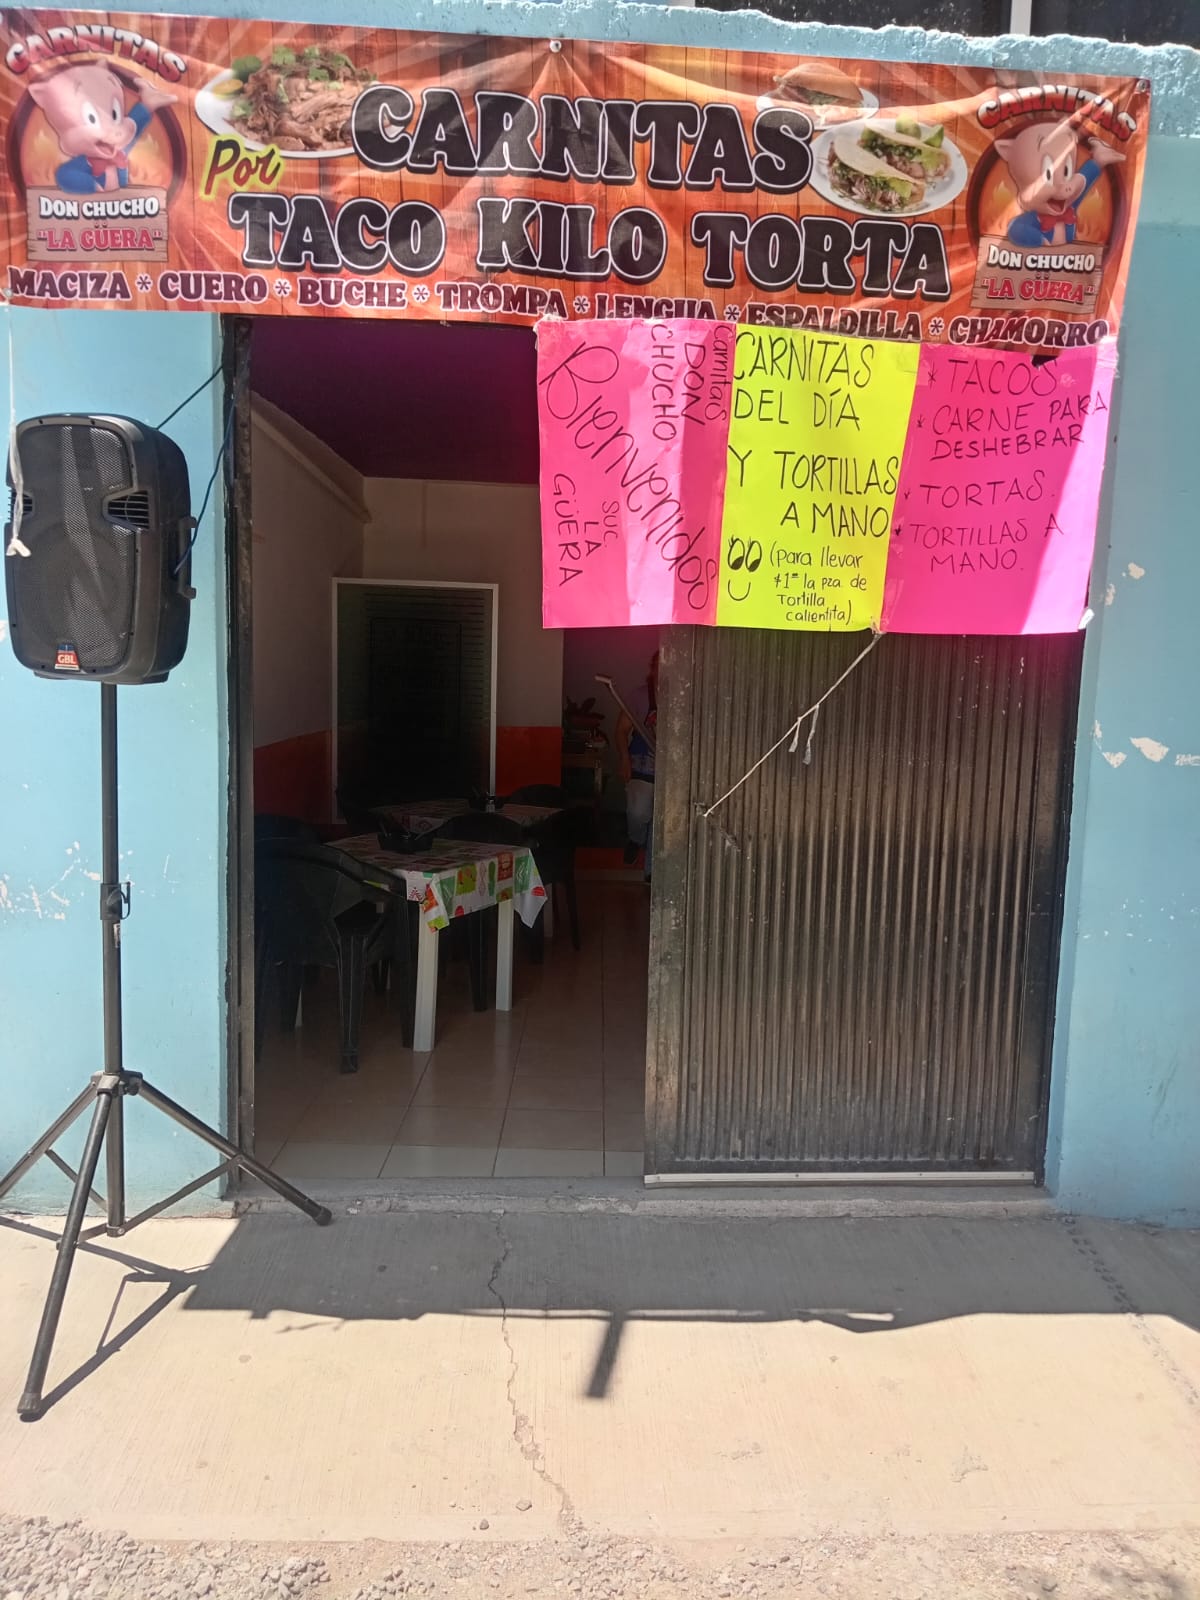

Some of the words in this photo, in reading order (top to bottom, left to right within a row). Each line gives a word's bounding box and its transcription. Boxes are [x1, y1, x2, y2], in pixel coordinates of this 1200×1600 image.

[5, 24, 187, 82] CARNITAS
[351, 84, 814, 191] CARNITAS
[203, 139, 282, 196] Por
[39, 196, 79, 217] DON
[81, 197, 160, 218] CHUCHO
[37, 228, 77, 251] "LA
[228, 193, 447, 274] TACO
[475, 198, 667, 281] KILO
[690, 212, 952, 300] TORTA
[986, 244, 1022, 270] DON
[1024, 253, 1095, 272] CHUCHO
[7, 267, 131, 299] MACIZA
[158, 270, 268, 302] CUERO
[297, 277, 408, 307] BUCHE
[435, 281, 567, 317] TROMPA
[595, 293, 717, 320] LENGUA
[747, 302, 922, 342] ESPALDILLA
[949, 316, 1109, 348] CHAMORRO
[704, 325, 734, 421] Carnitas
[733, 331, 875, 389] CARNITAS
[947, 358, 1058, 396] TACOS
[651, 323, 680, 441] CHUCHO
[680, 342, 706, 426] DON
[734, 388, 790, 425] DEL
[813, 388, 861, 432] DÍA
[932, 402, 1035, 436] CARNE
[1048, 391, 1109, 424] PARA
[929, 423, 1084, 462] DESHEBRAR
[727, 444, 753, 488] Y
[773, 450, 899, 496] TORTILLAS
[552, 473, 584, 588] GÜERA
[583, 521, 602, 557] LA
[780, 501, 800, 529] A
[811, 502, 890, 538] MANO
[909, 518, 1028, 550] TORTILLAS
[1044, 512, 1065, 539] A
[769, 540, 812, 569] (para
[820, 545, 864, 569] llevar
[776, 591, 826, 607] Tortilla
[803, 572, 816, 590] la
[821, 577, 841, 590] pza
[850, 573, 867, 591] de
[785, 599, 852, 626] calientita)
[57, 654, 77, 665] GBL
